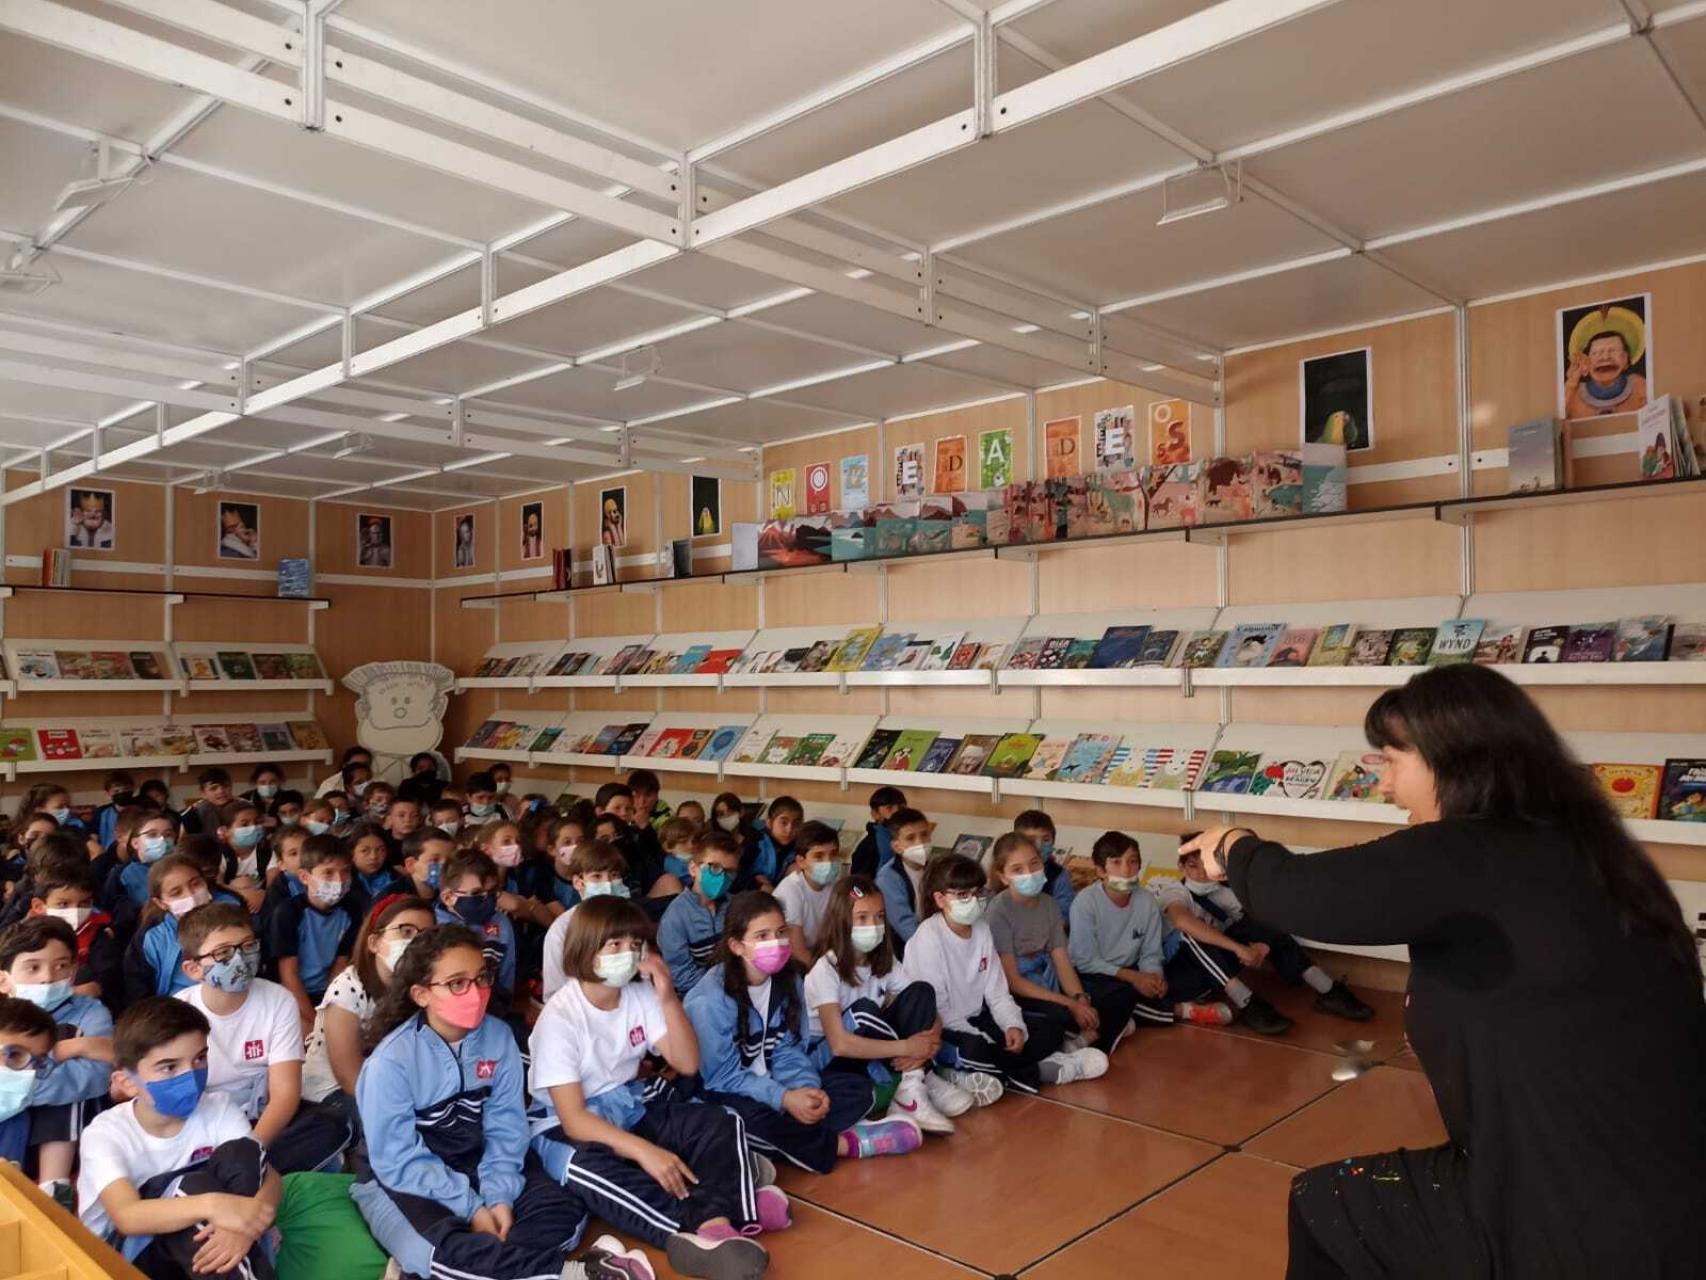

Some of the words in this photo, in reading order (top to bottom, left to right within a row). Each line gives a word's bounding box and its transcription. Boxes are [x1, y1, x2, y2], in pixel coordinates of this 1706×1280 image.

[987, 438, 1006, 465] A
[1058, 437, 1076, 456] D
[1104, 428, 1126, 456] E
[901, 460, 918, 485] E
[948, 455, 964, 472] D
[1438, 638, 1471, 650] WYND
